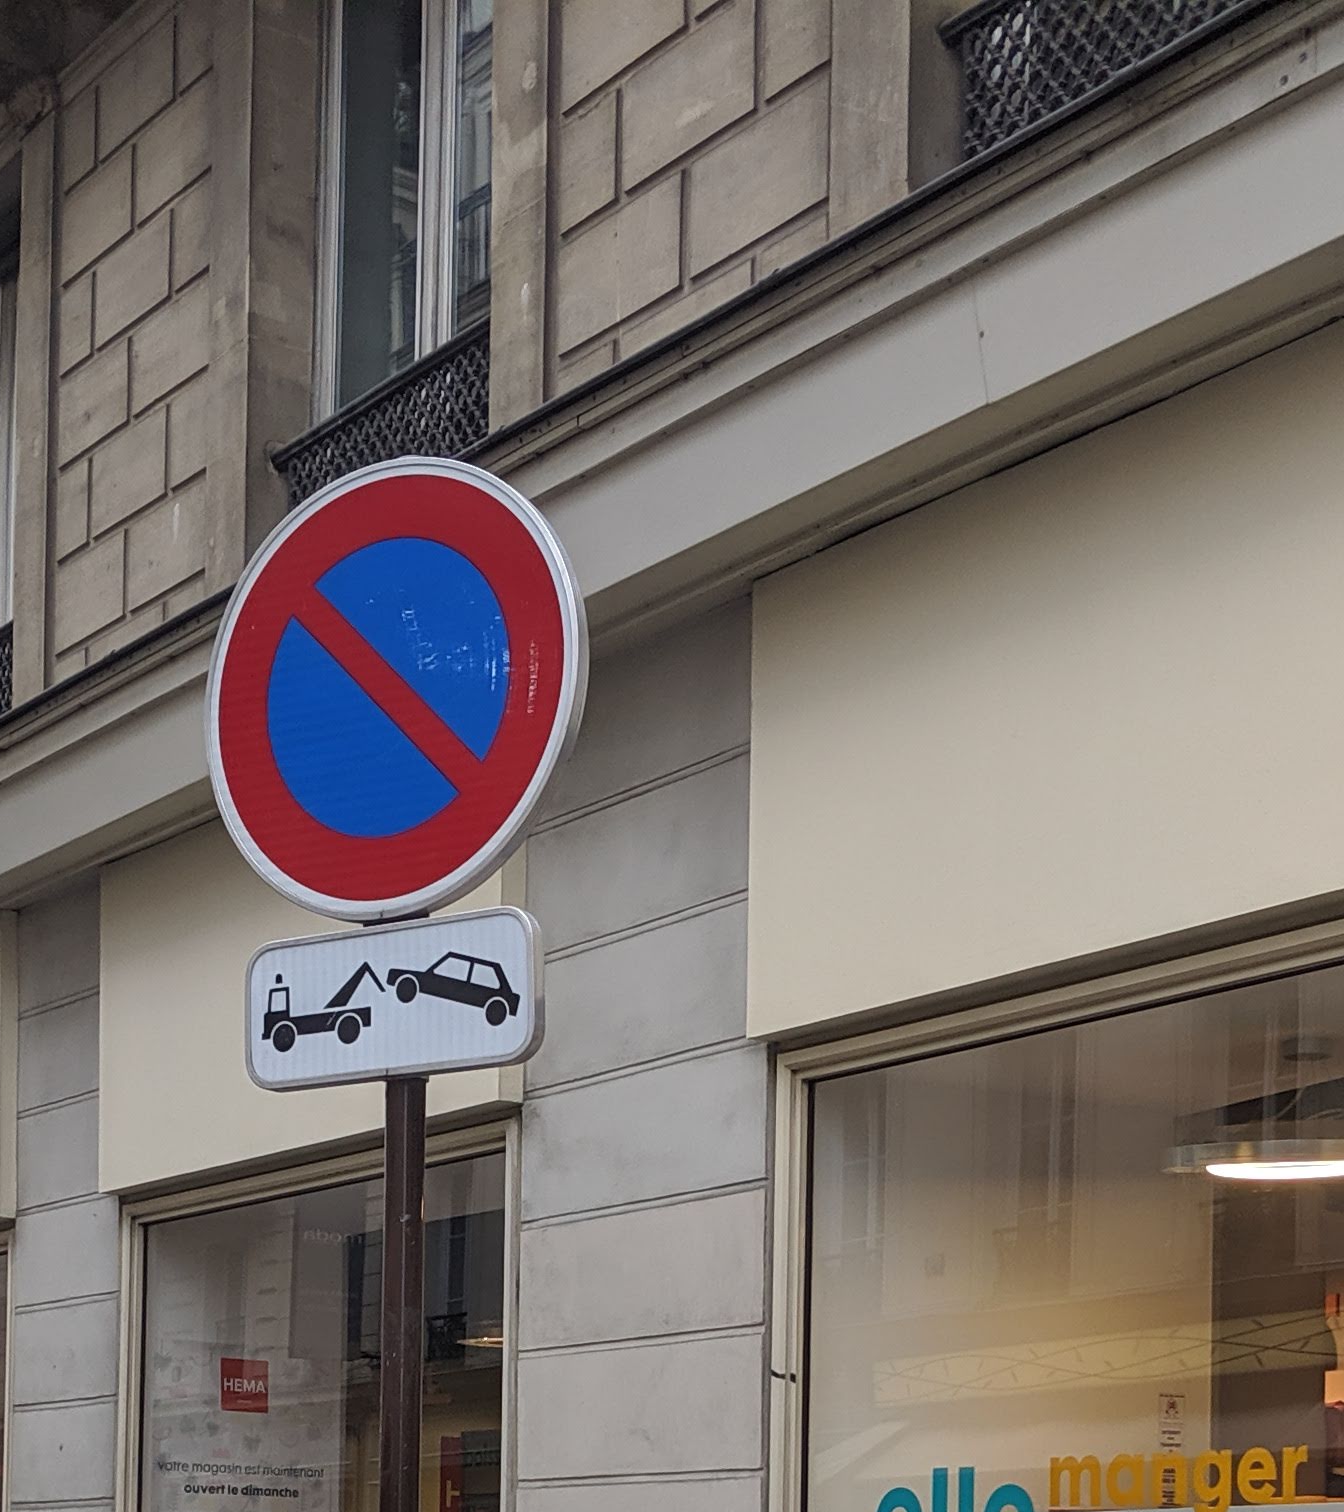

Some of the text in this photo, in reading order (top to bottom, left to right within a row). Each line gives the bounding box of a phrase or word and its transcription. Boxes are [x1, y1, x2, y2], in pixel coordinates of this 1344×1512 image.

[223, 1377, 267, 1394] HEMA
[192, 1461, 242, 1475] magasin
[184, 1483, 299, 1498] ouvert le dimanche
